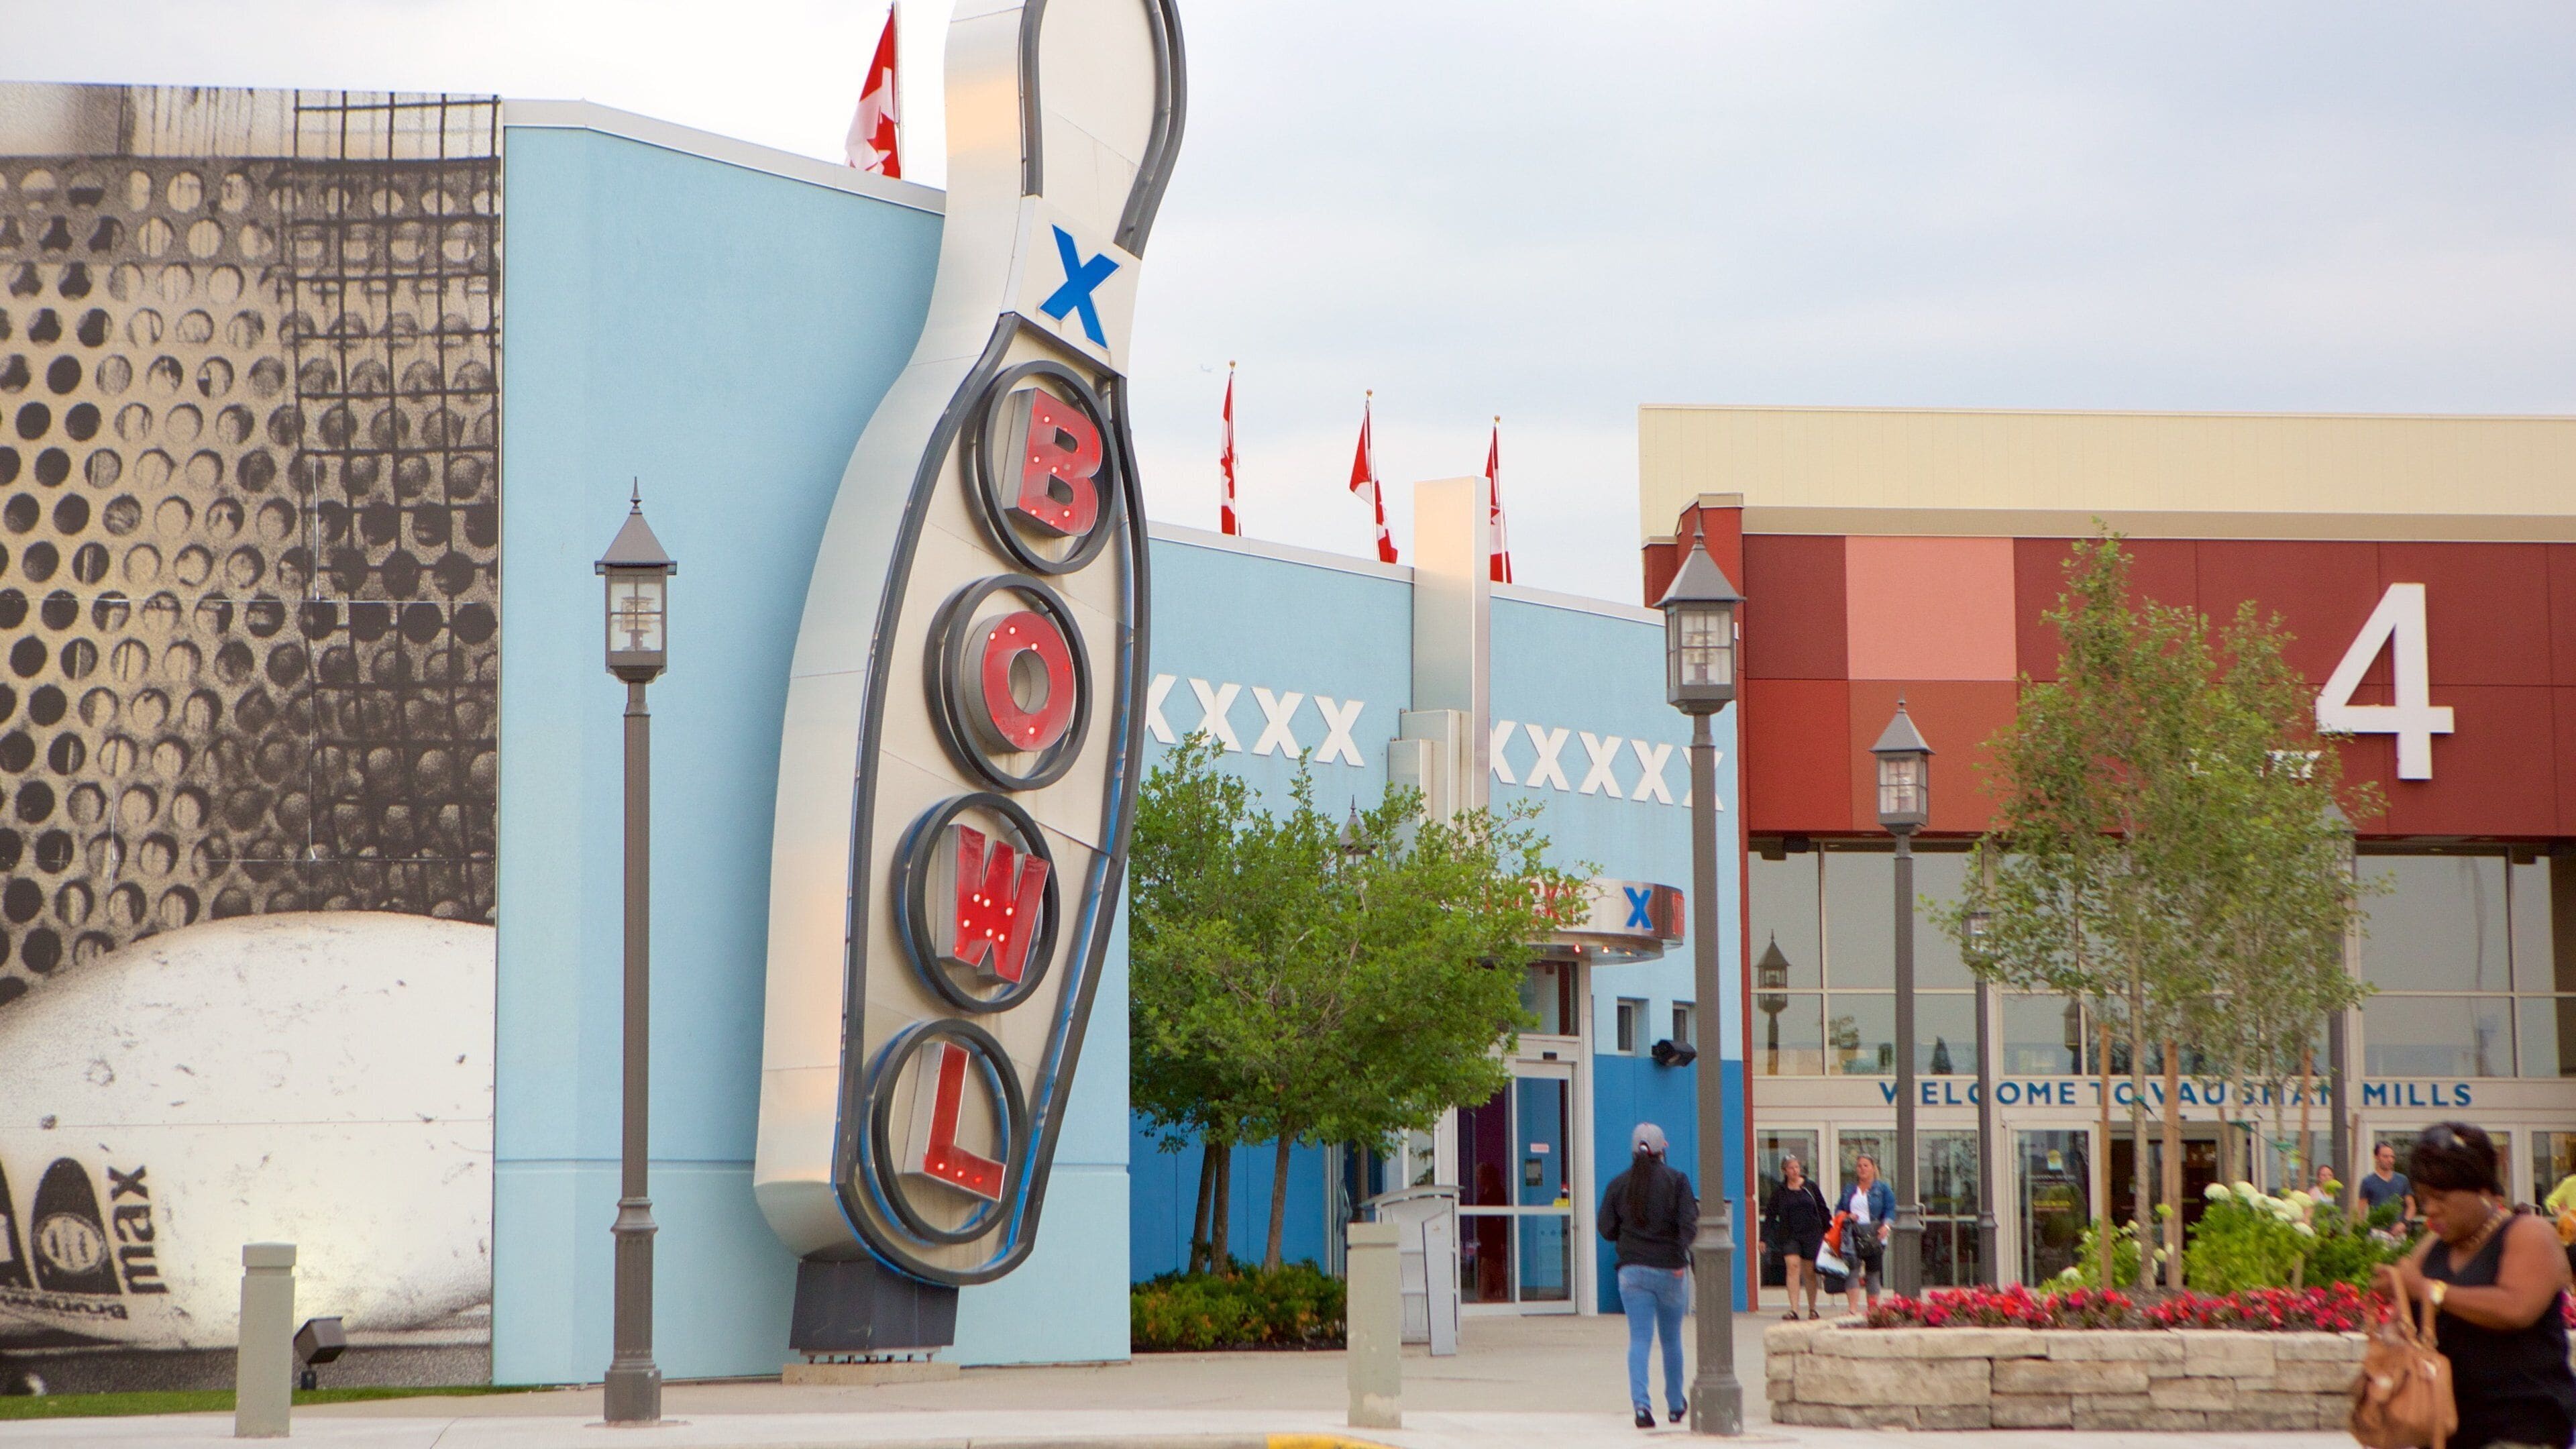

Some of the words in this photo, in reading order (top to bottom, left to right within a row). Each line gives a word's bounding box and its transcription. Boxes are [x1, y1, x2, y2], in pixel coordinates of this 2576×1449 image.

[1039, 223, 1121, 350] X
[2316, 582, 2455, 780] 4
[1623, 887, 1653, 930] X
[2363, 1083, 2472, 1106] MILLS
[107, 1165, 170, 1294] max
